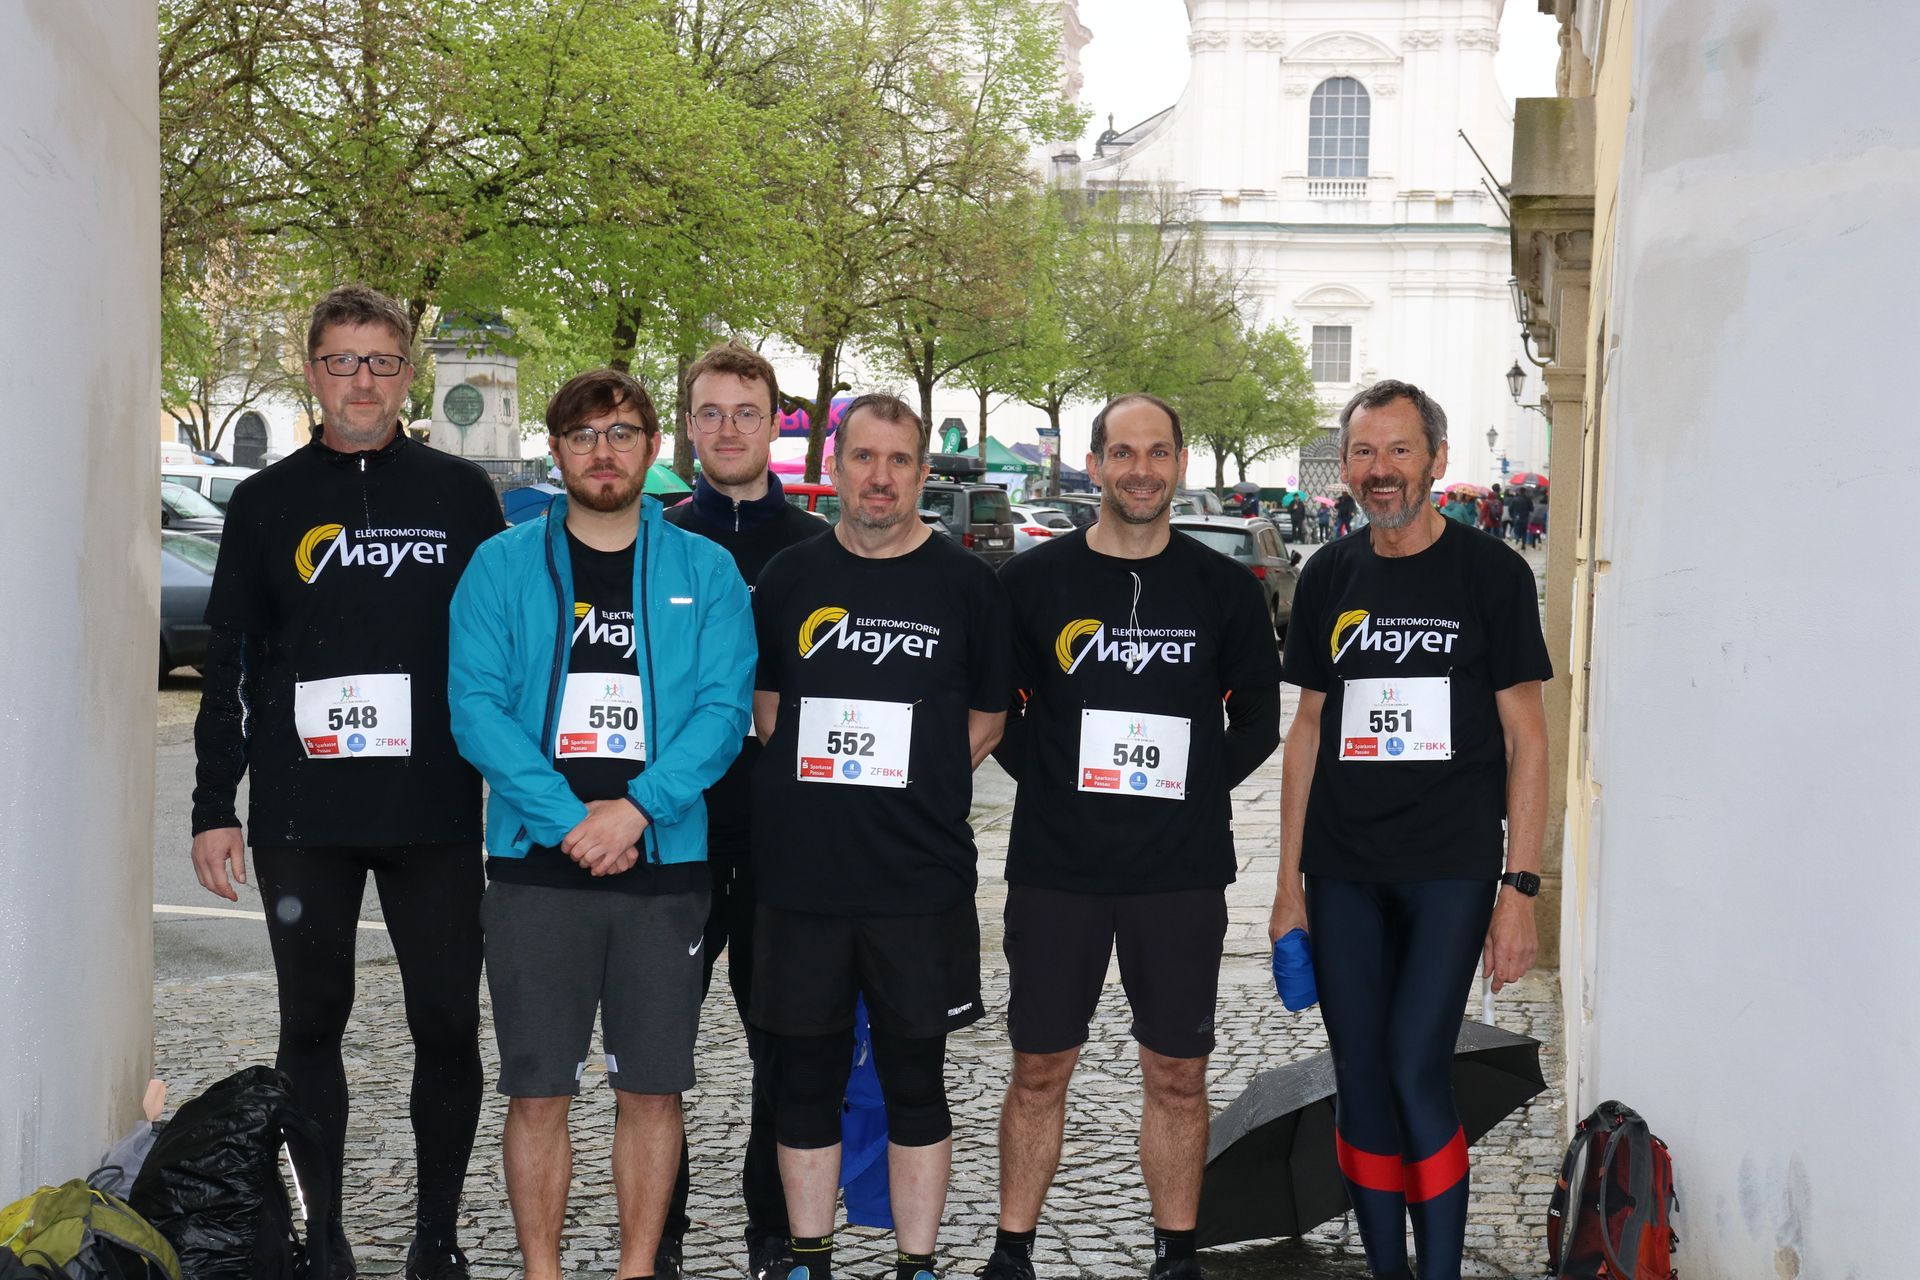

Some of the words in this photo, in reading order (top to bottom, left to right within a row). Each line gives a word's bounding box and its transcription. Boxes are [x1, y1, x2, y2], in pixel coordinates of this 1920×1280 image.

[355, 528, 446, 539] ELEKTROMOTOREN
[307, 527, 448, 584] Mayer
[856, 617, 940, 636] ELEKTROMOTOREN
[1112, 627, 1196, 637] ELEKTROMOTOREN
[1376, 617, 1460, 630] ELEKTROMOTOREN
[803, 612, 939, 665] Mayer
[1333, 613, 1458, 664] Mayer
[1066, 622, 1197, 675] Mayer
[328, 705, 378, 731] 548
[589, 705, 638, 730] 550
[1369, 709, 1413, 733] 551
[375, 738, 407, 746] ZFBKK
[570, 739, 596, 747] Sparkasse
[827, 731, 875, 756] 552
[1413, 742, 1447, 751] ZFBKK
[1113, 743, 1160, 769] 549
[870, 767, 903, 777] ZFBKK
[1094, 774, 1119, 782] Sparkasse
[1155, 779, 1182, 789] ZFBKK
